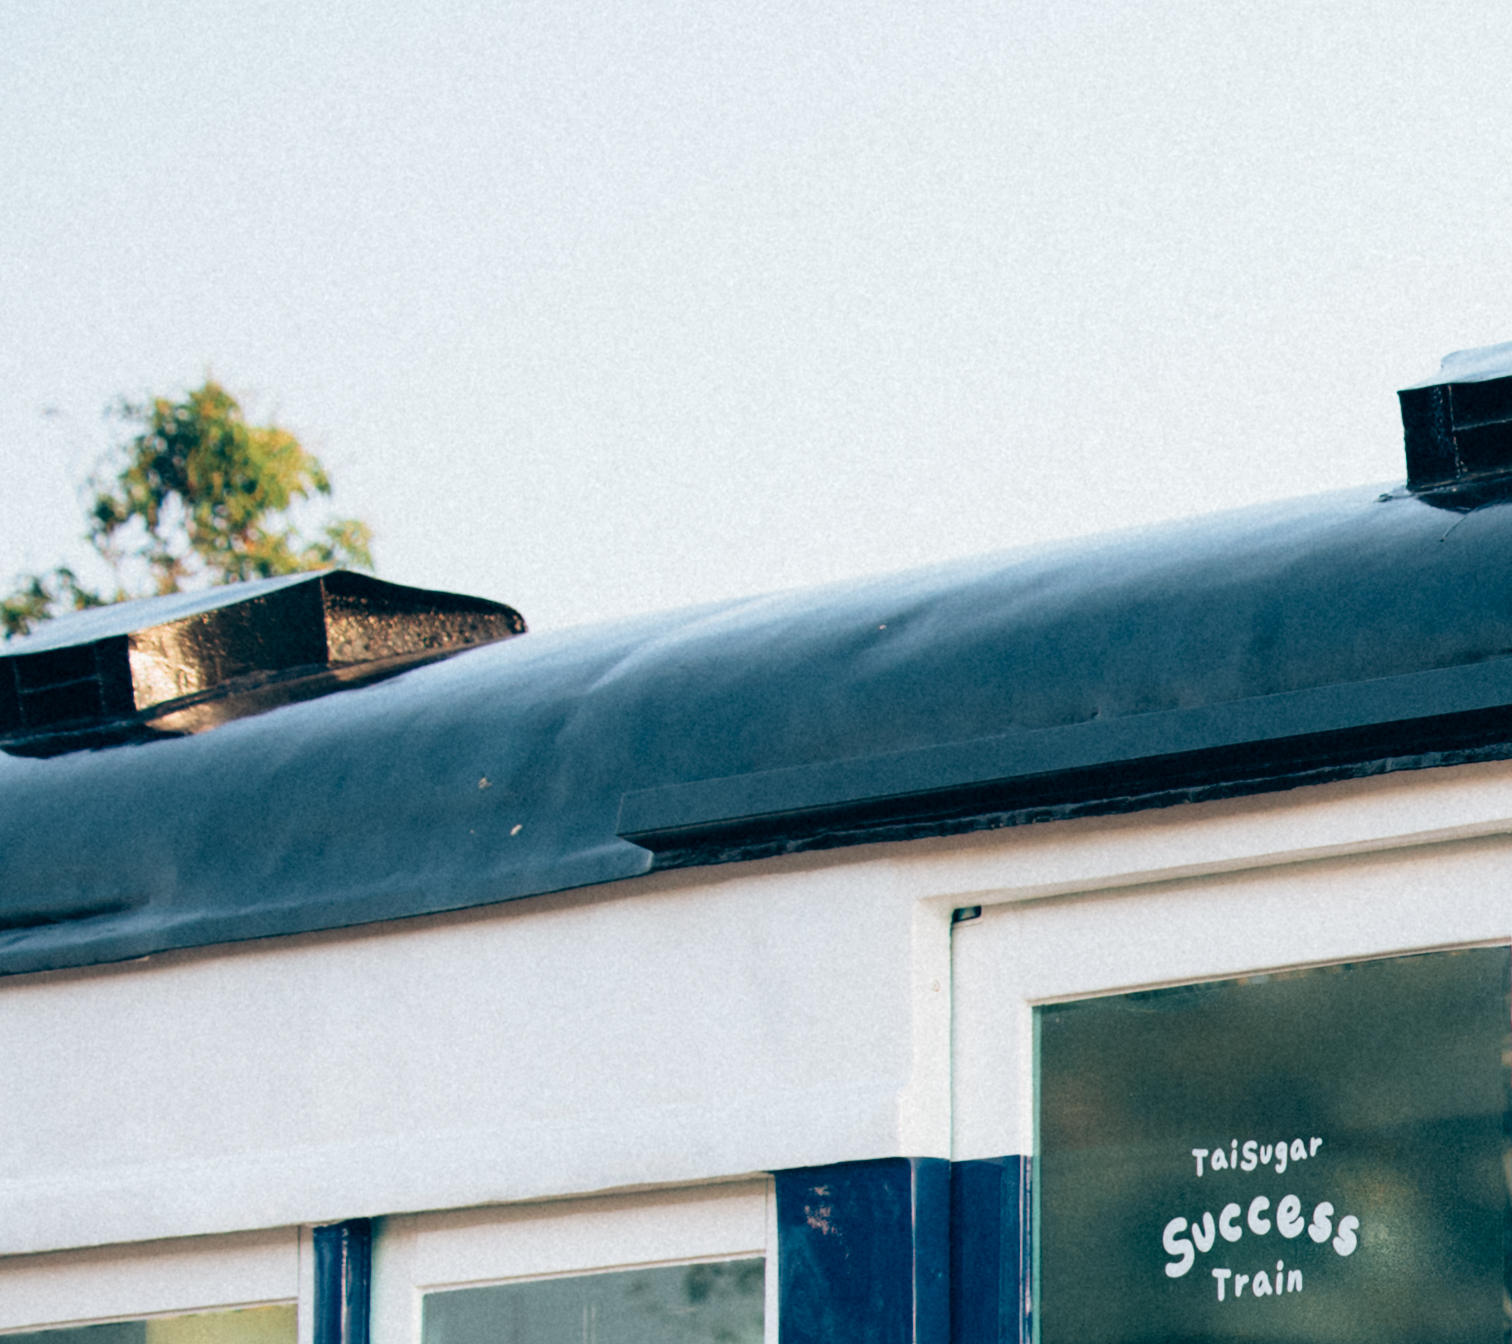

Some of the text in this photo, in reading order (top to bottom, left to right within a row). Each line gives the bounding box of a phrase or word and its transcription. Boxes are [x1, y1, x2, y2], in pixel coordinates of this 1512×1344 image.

[1192, 1136, 1323, 1177] TaiSugar
[1162, 1194, 1360, 1278] Success
[1211, 1259, 1303, 1302] Train
